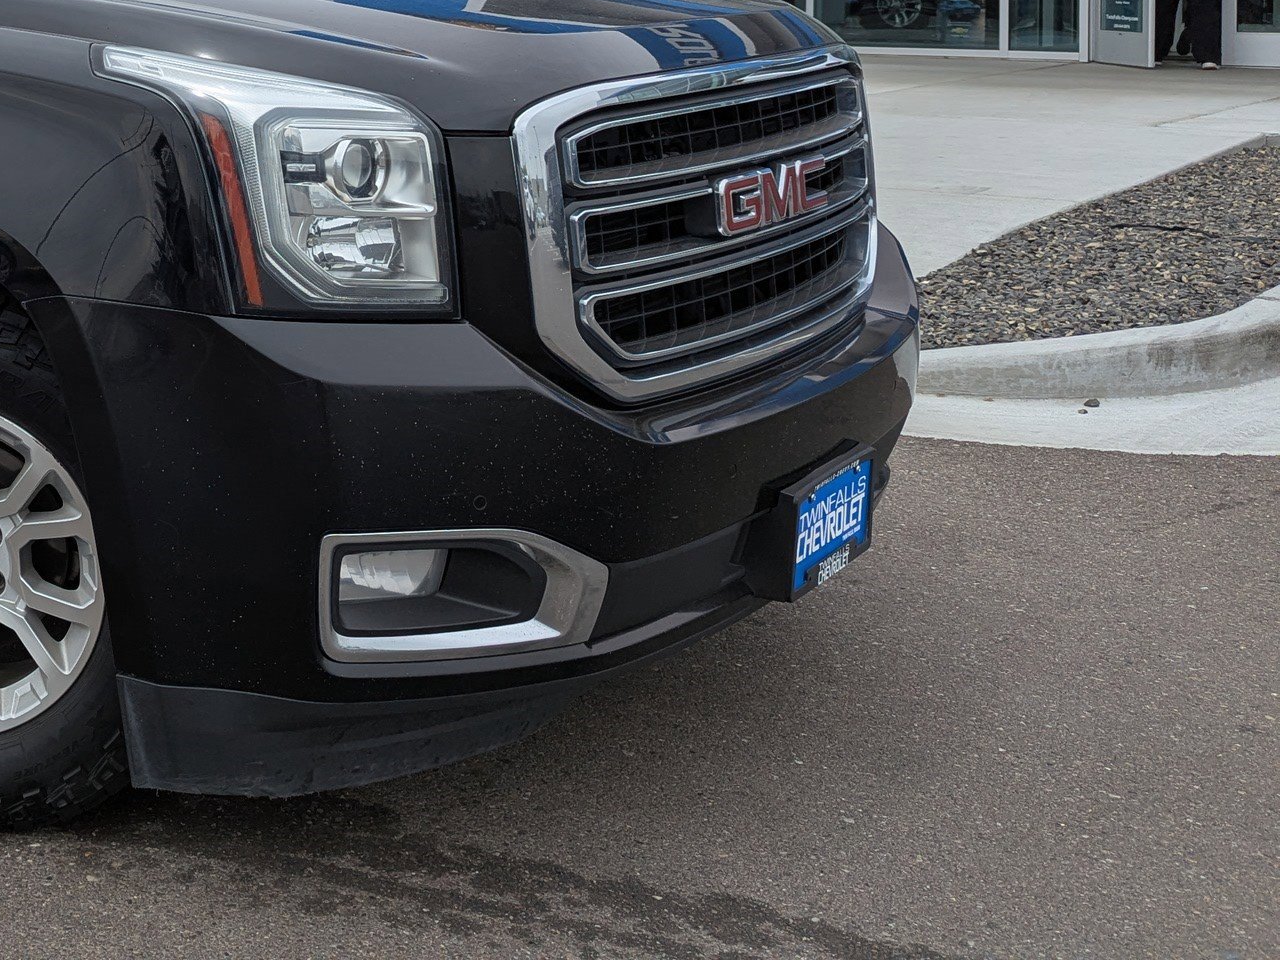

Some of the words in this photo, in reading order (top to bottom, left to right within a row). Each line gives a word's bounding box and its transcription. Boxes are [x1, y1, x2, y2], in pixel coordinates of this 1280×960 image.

[716, 154, 829, 237] GMC
[796, 492, 866, 563] CHEVROLET
[799, 475, 867, 531] TWINFALLS
[817, 551, 850, 586] CHEVROLET
